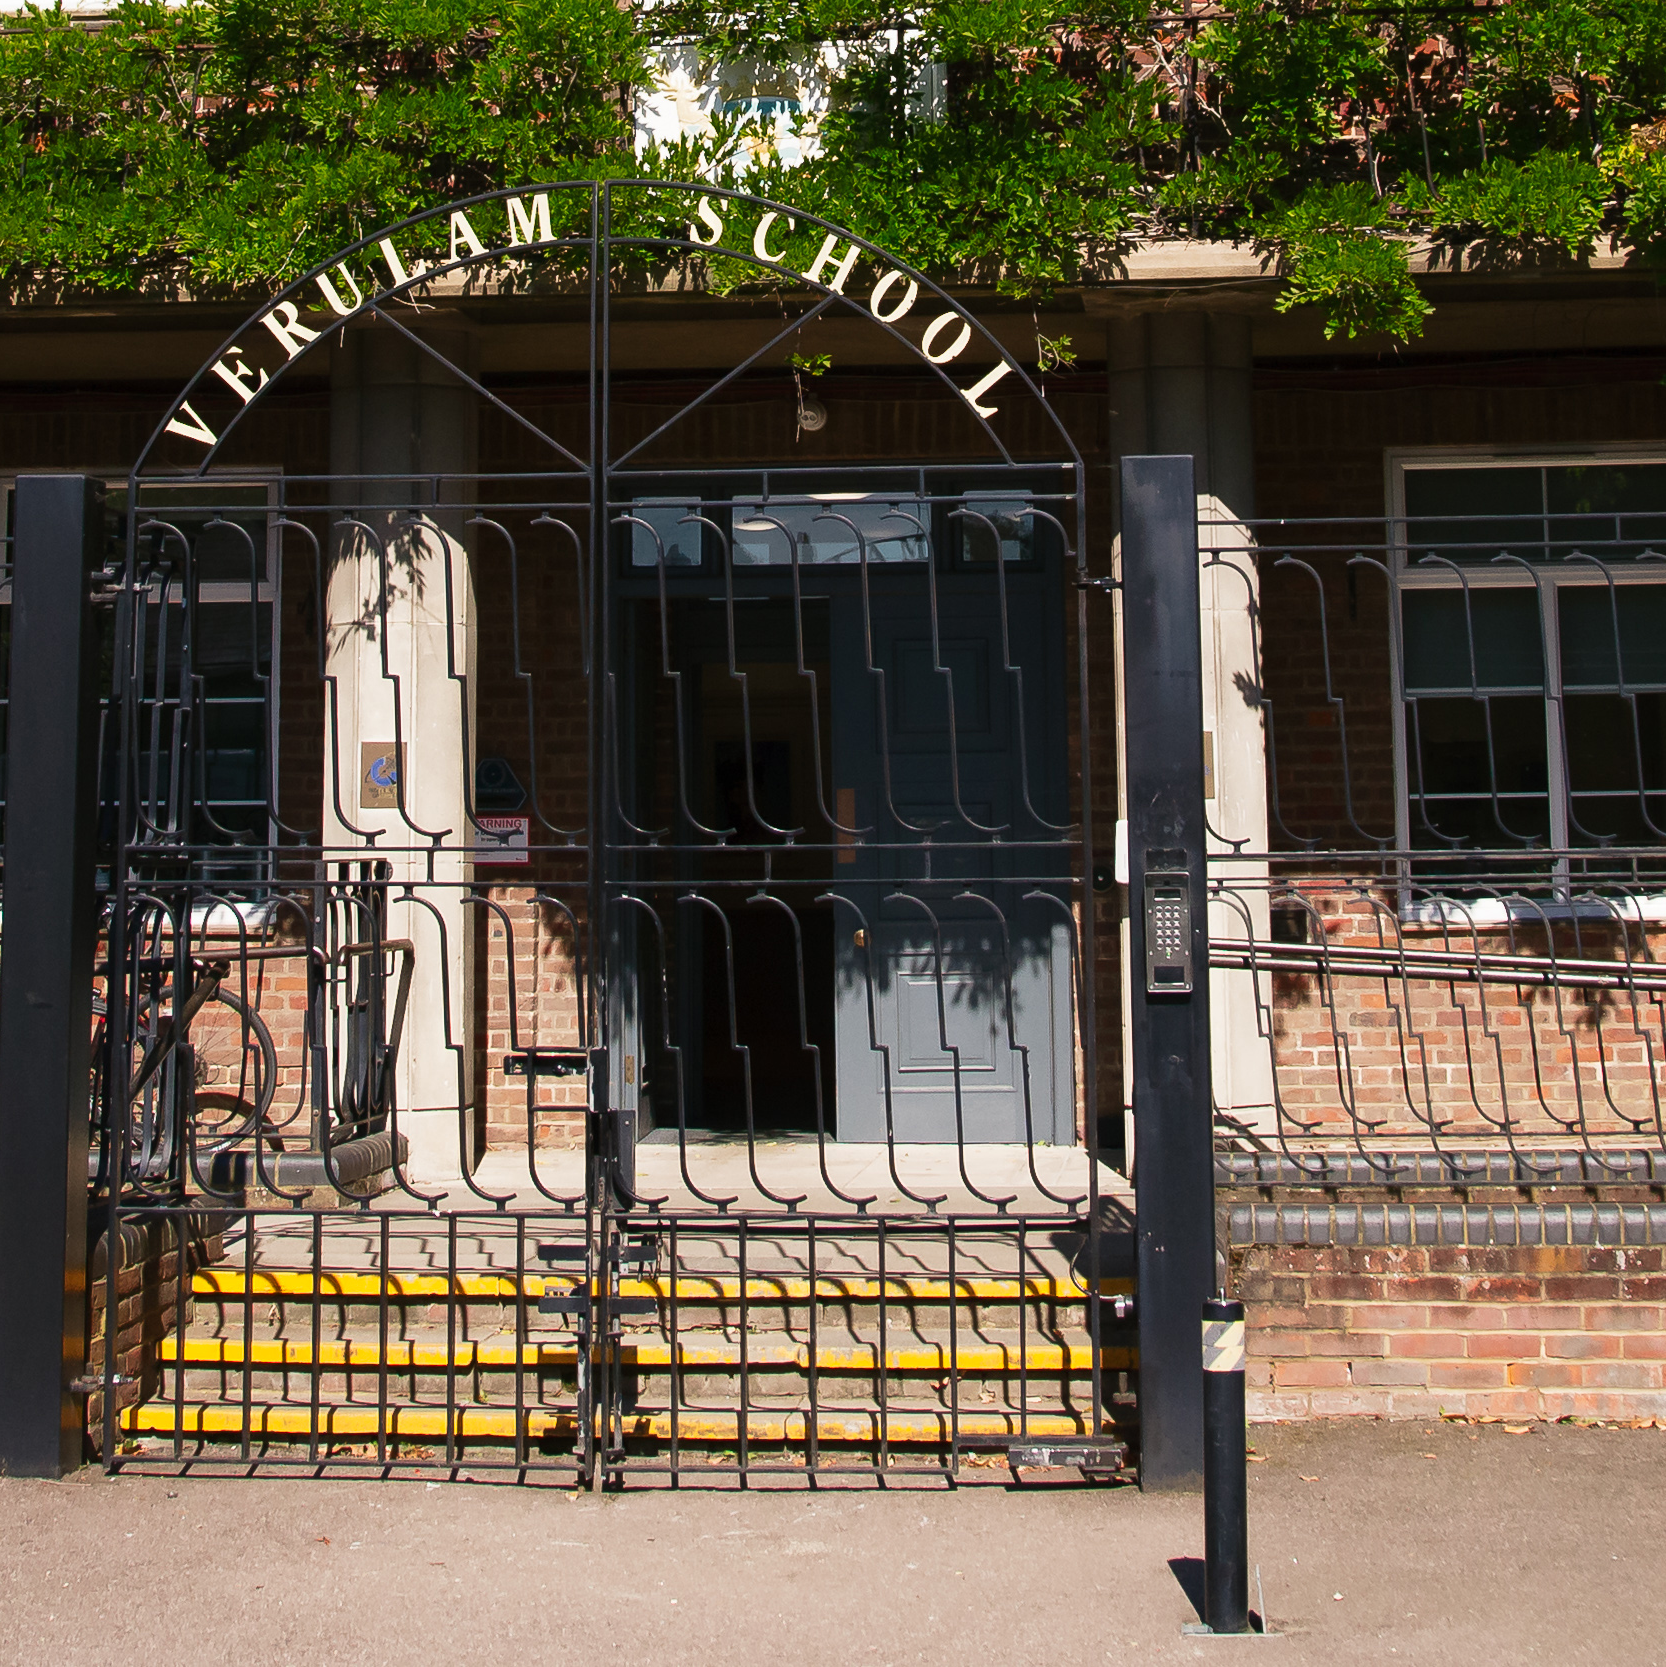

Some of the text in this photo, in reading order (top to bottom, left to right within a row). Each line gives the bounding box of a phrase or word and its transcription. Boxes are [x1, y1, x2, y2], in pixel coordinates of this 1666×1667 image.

[165, 194, 1015, 446] VERULAM SCHOOL
[477, 819, 522, 829] ARNING
